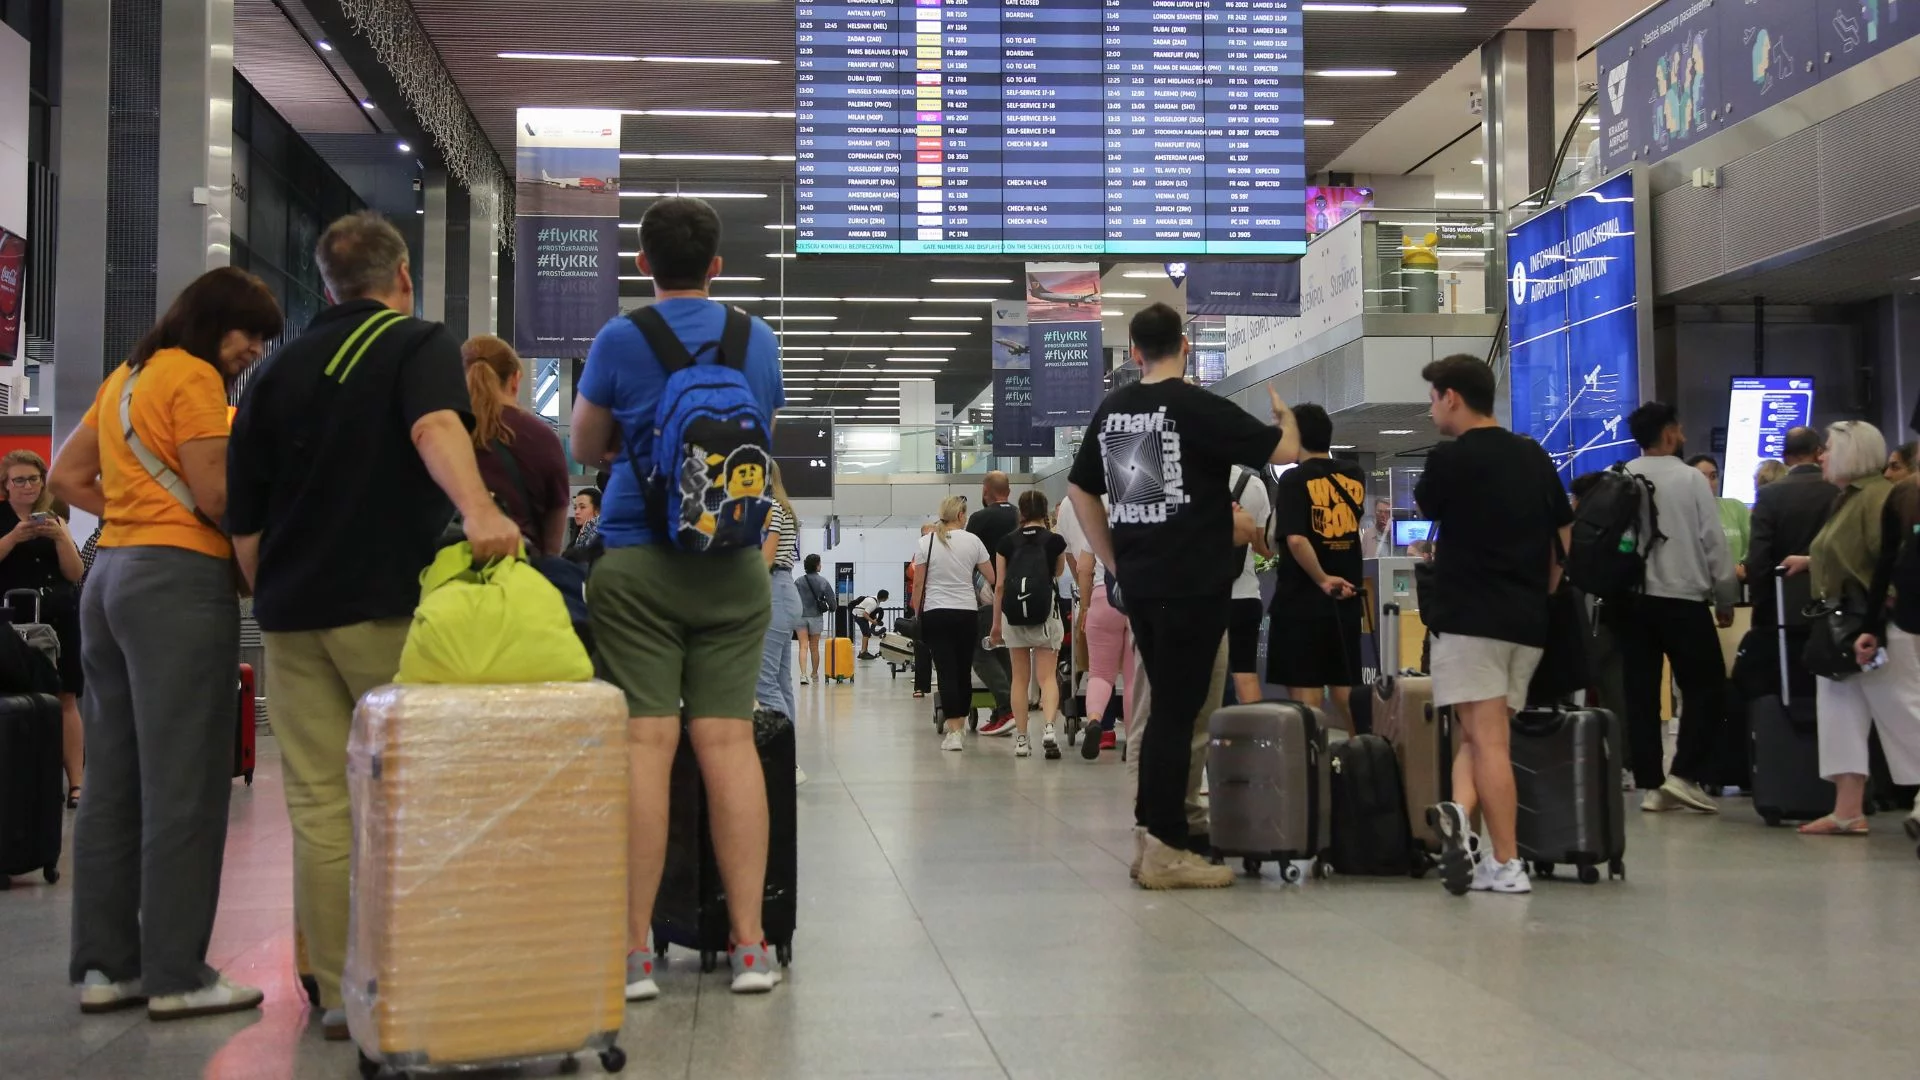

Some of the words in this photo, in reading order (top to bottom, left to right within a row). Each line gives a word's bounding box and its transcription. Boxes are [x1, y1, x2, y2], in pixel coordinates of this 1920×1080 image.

[1609, 118, 1628, 137] KRAKÓW
[1609, 130, 1628, 149] AIRPORT
[538, 228, 599, 245] #flyKRK
[1573, 217, 1619, 254] LOTNISKOWA
[537, 254, 598, 270] #flyKRK
[1330, 266, 1358, 297] SUEMPOL
[1531, 276, 1558, 303] AIRPORT
[1559, 256, 1606, 291] INFORMATION
[1044, 330, 1088, 343] #flyKRK
[1045, 350, 1088, 362] #flyKRK
[1005, 376, 1030, 386] #flyK
[1005, 392, 1031, 402] #flyK
[1106, 406, 1167, 433] mavi
[1161, 431, 1191, 504] mavi
